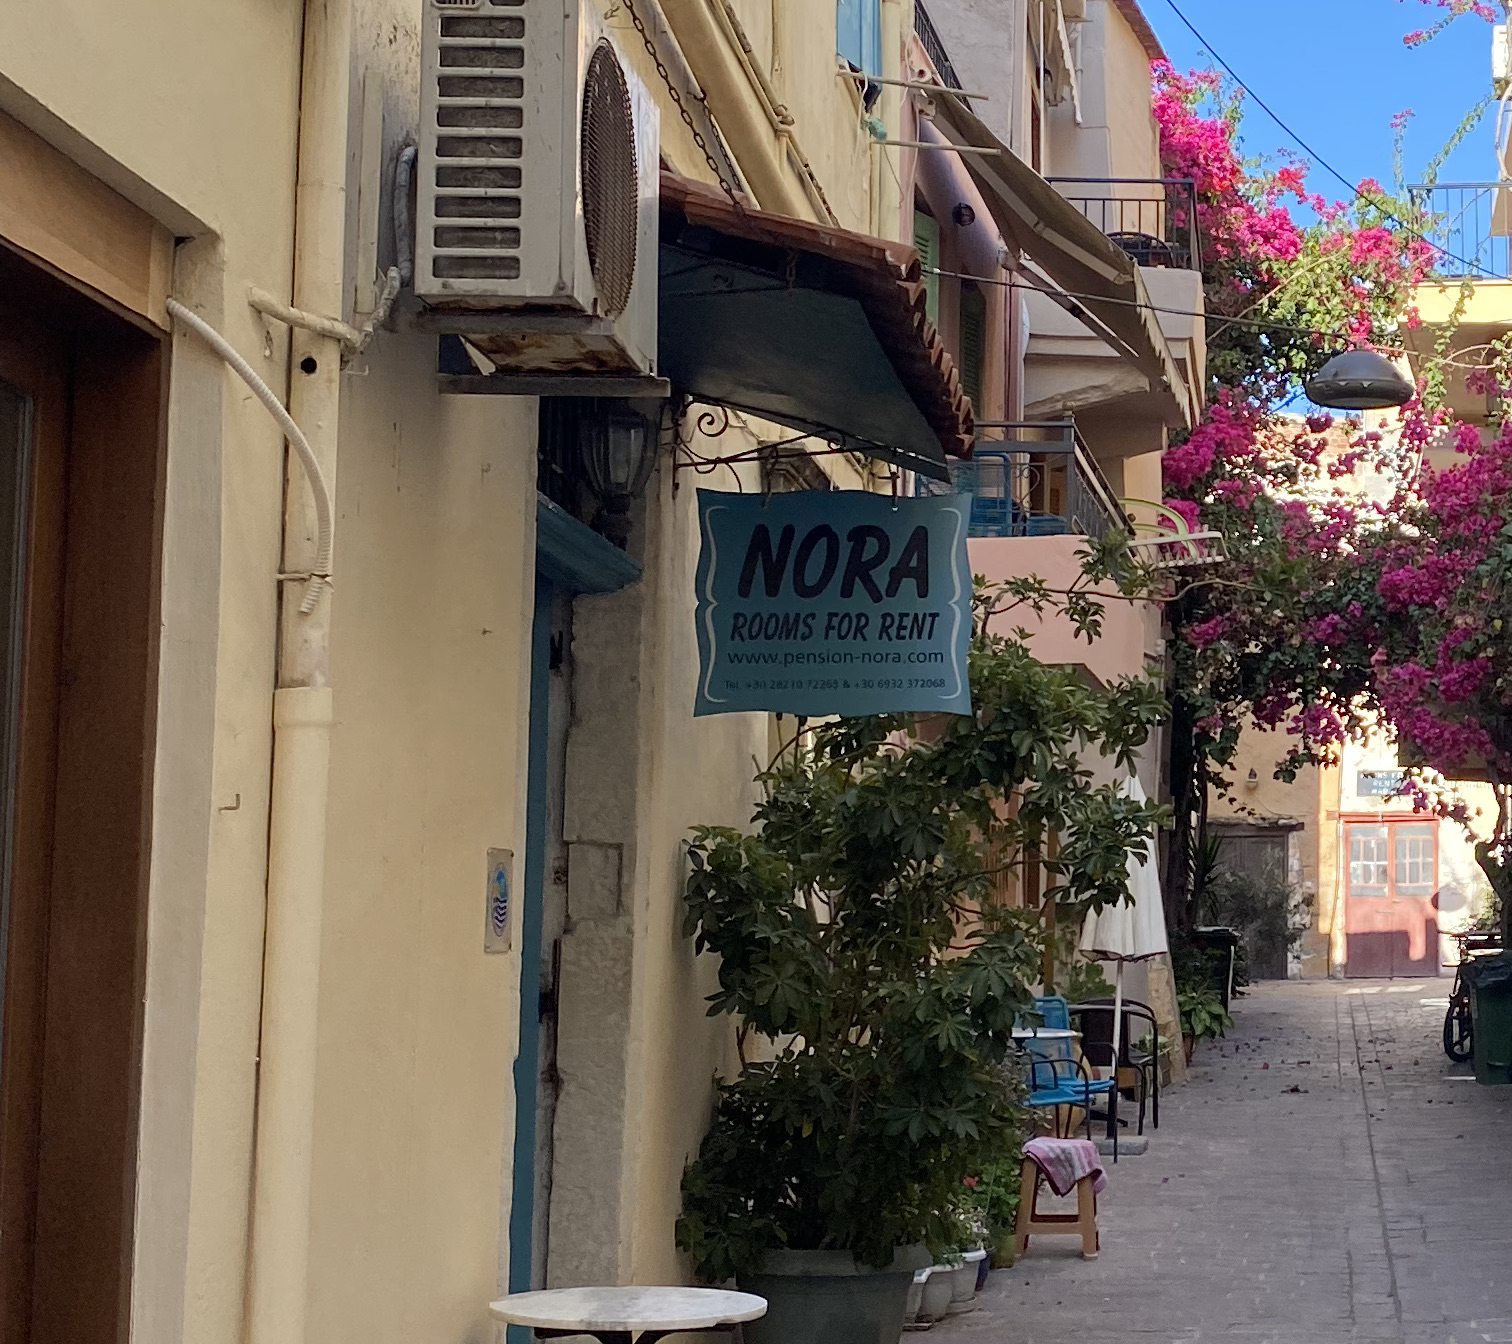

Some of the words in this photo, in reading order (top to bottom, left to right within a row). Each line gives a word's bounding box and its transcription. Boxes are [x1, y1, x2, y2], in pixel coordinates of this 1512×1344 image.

[737, 523, 929, 604] NORA
[729, 611, 816, 642] ROOMS
[824, 611, 869, 642] FOR
[878, 611, 940, 642] RENT
[727, 648, 944, 667] www.pension-nora.com
[854, 679, 875, 689] +30
[878, 679, 903, 689] 6932
[907, 678, 946, 689] 372068
